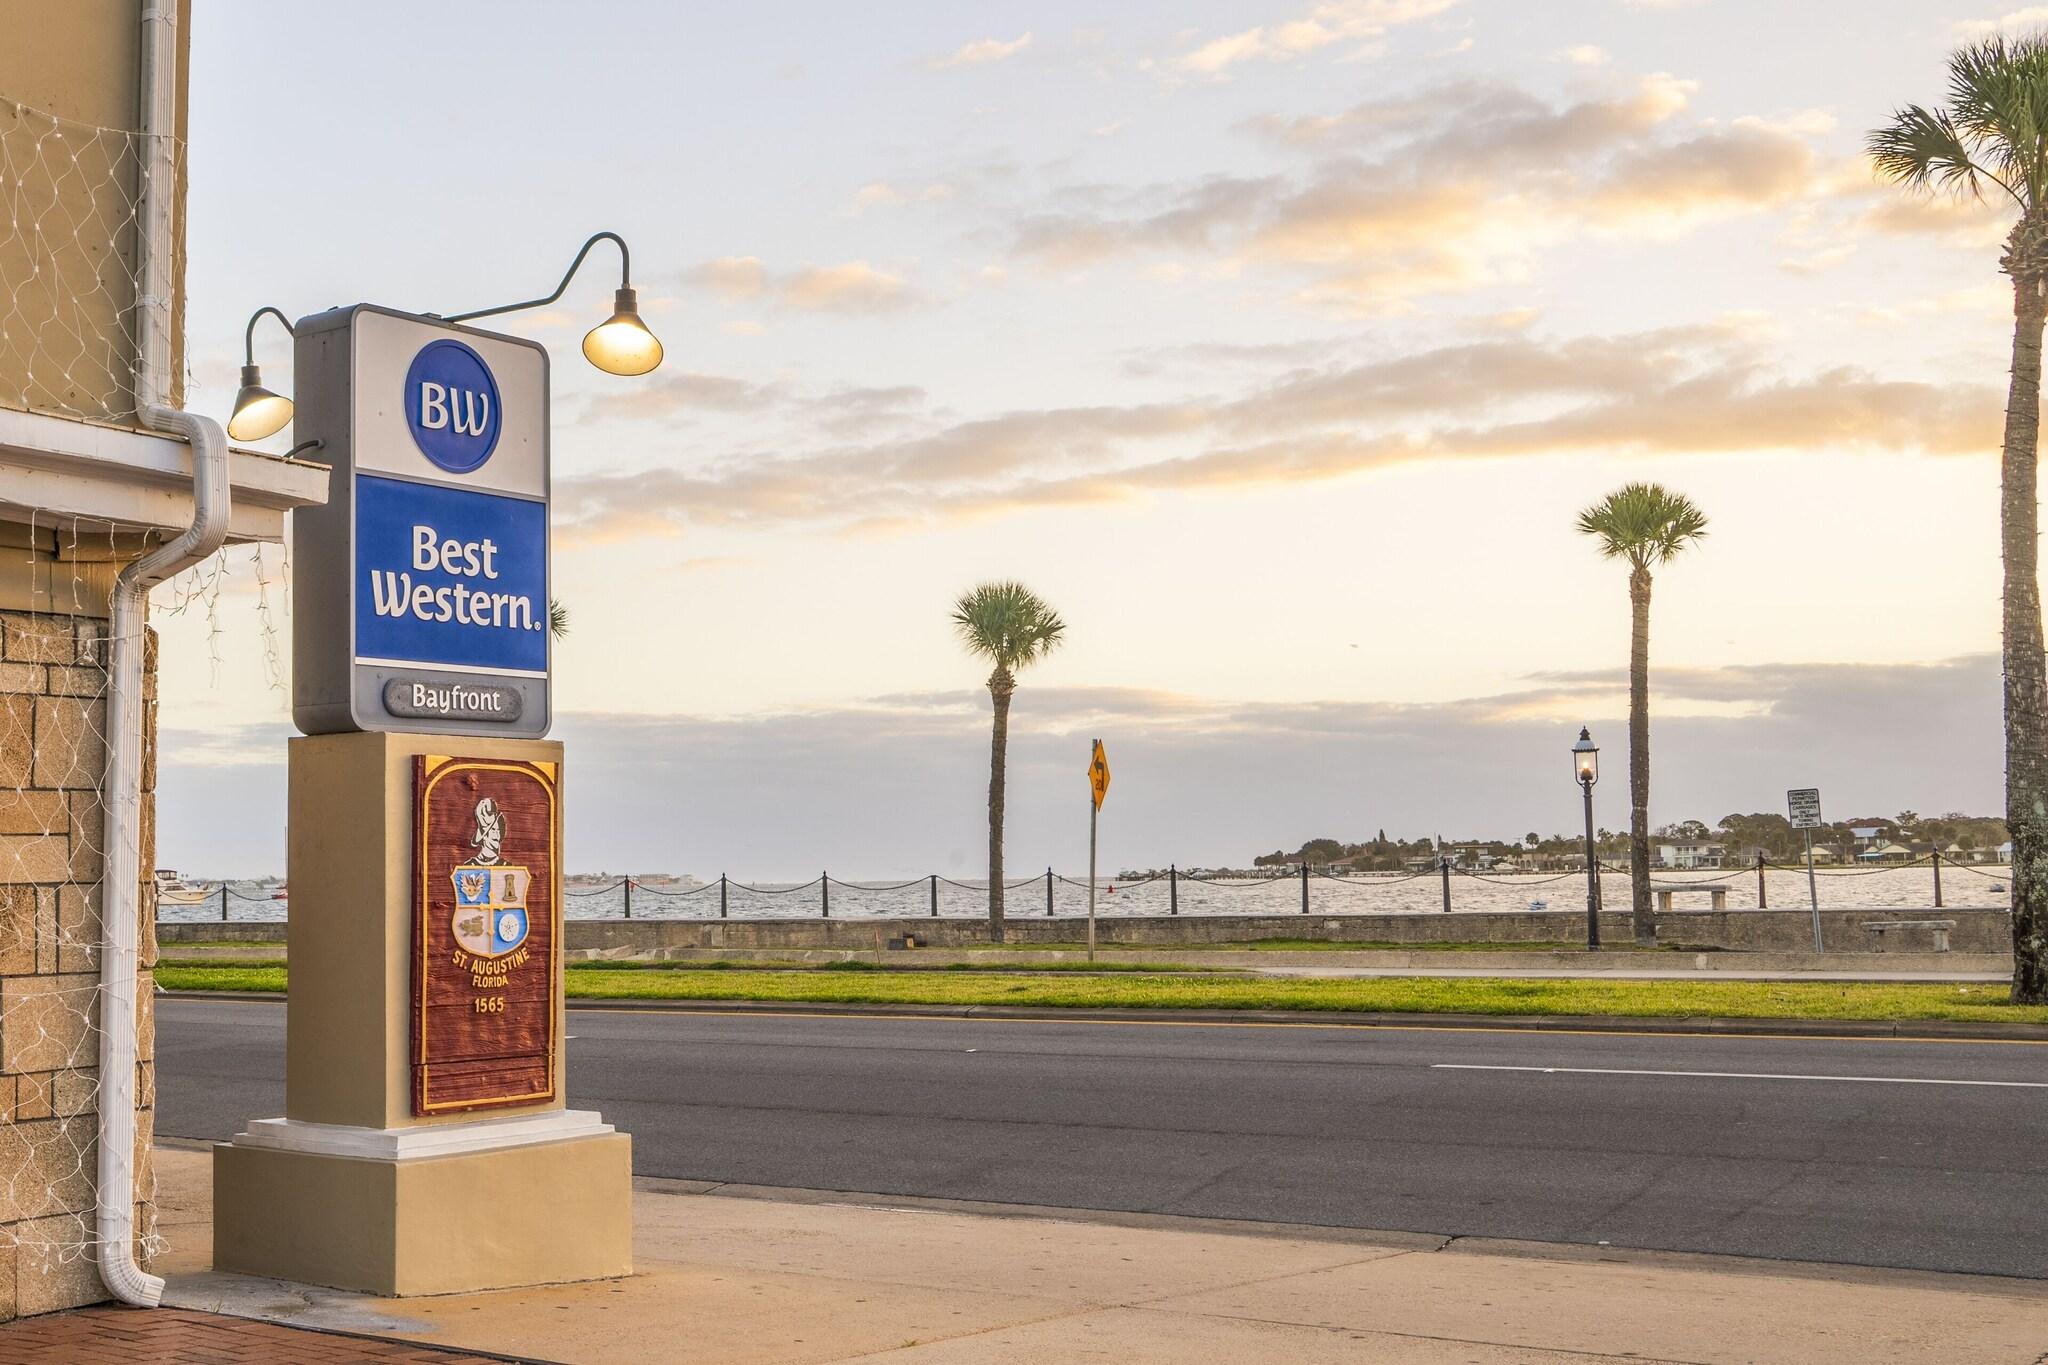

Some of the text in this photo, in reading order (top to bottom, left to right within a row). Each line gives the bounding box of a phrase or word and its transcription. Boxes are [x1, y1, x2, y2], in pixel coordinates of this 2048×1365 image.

[421, 382, 489, 437] BW
[412, 526, 498, 579] Best
[412, 683, 501, 713] Bayfront
[452, 947, 530, 973] ST. AUGUSTINE
[473, 974, 508, 987] FLORIDA
[475, 997, 505, 1013] 1565
